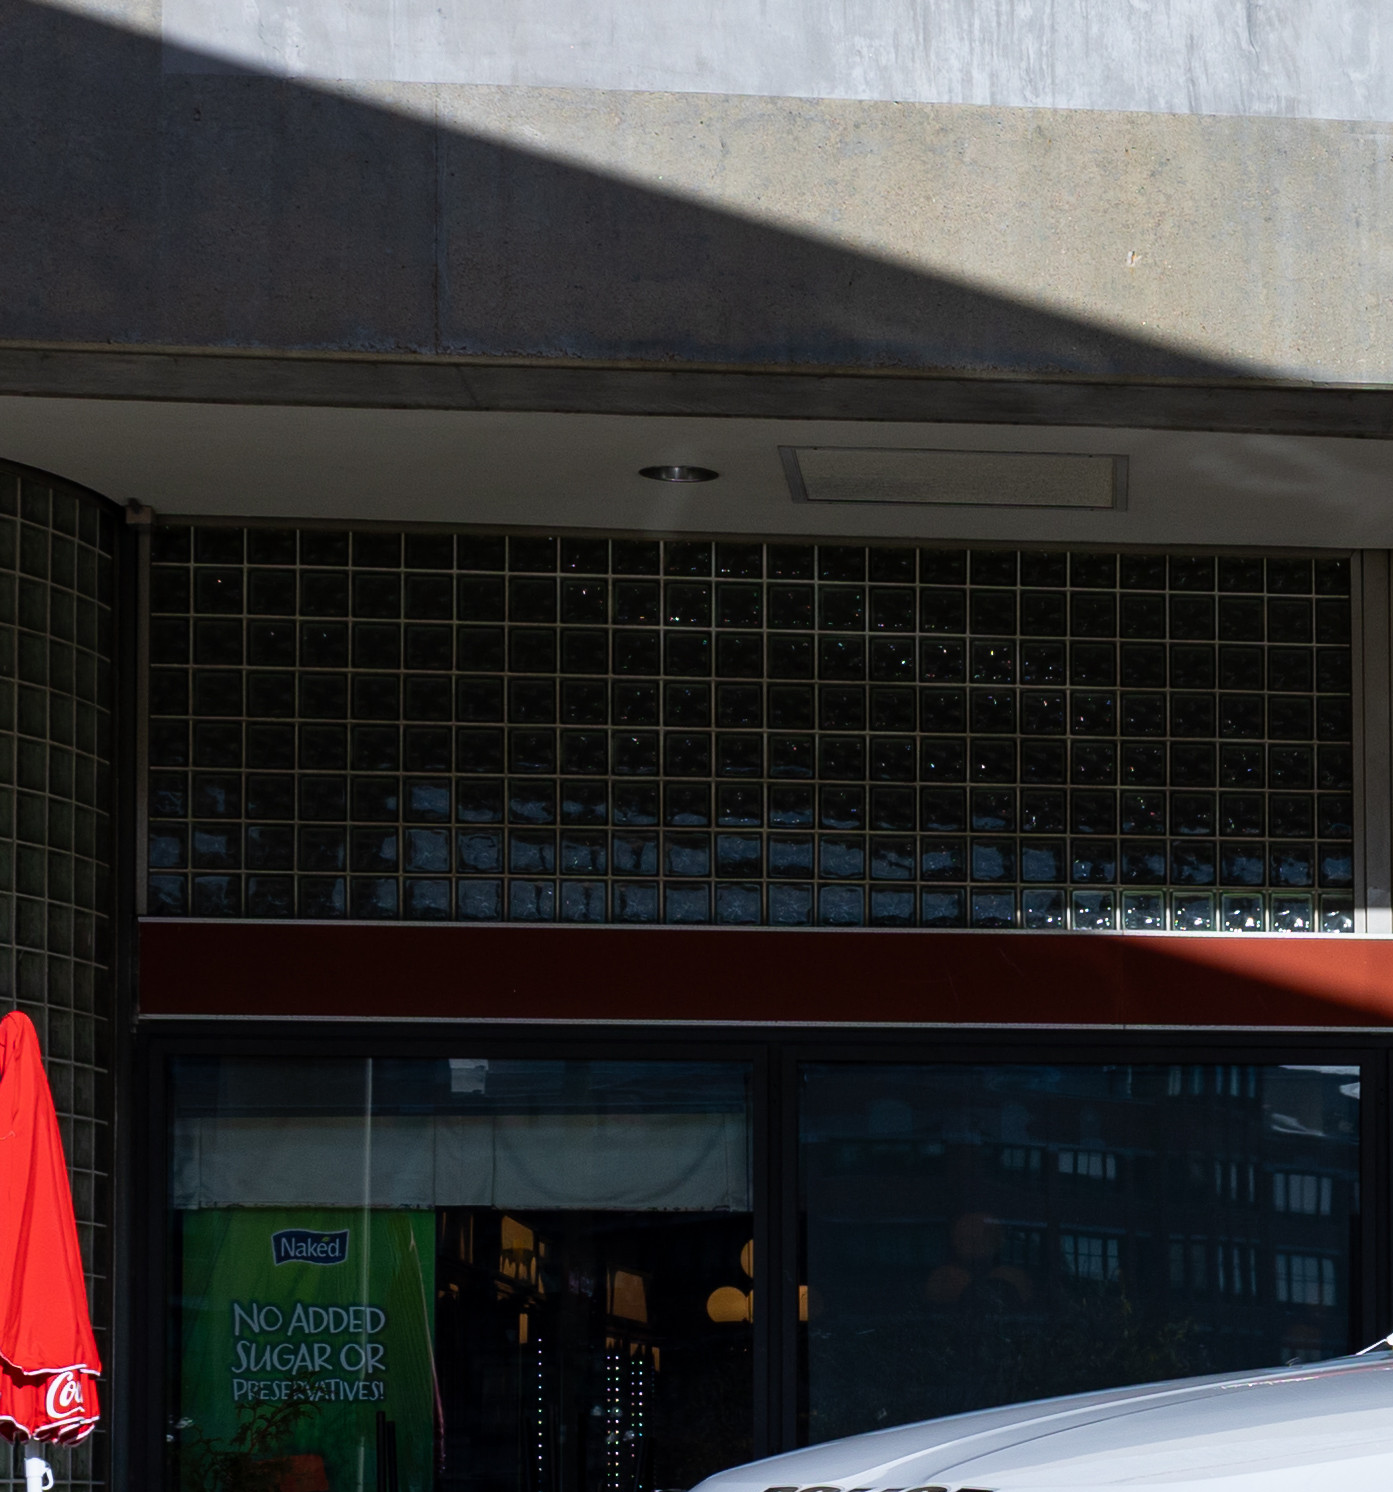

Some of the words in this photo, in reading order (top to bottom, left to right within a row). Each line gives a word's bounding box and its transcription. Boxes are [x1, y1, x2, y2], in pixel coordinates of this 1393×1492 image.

[281, 1237, 340, 1257] Naked
[233, 1303, 283, 1336] NO
[287, 1303, 386, 1336] ADDED
[231, 1340, 333, 1375] SUGAR
[340, 1343, 386, 1373] OR
[232, 1379, 384, 1401] PRESERVATIVES!
